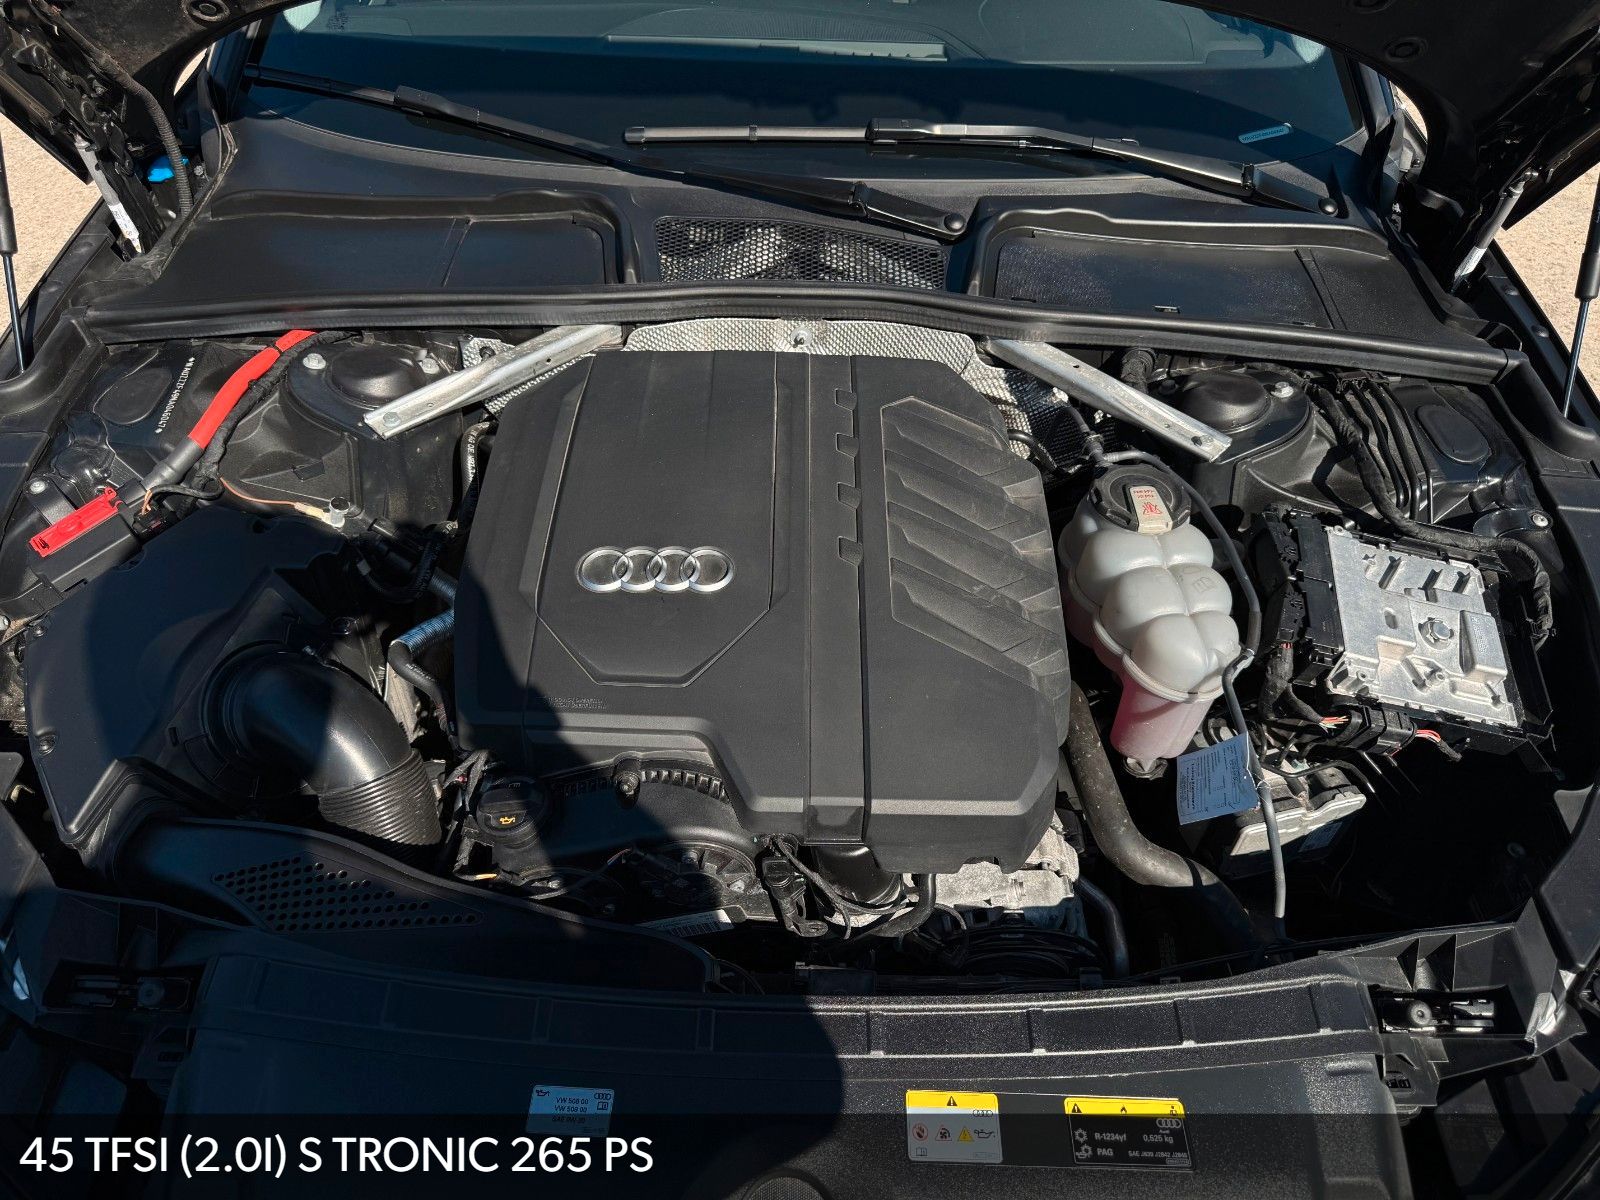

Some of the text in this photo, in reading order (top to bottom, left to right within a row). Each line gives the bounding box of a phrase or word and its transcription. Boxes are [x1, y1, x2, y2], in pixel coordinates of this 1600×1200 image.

[1094, 1132, 1127, 1142] R-1234yf
[1164, 1135, 1174, 1144] kg
[1096, 1147, 1114, 1156] PAG
